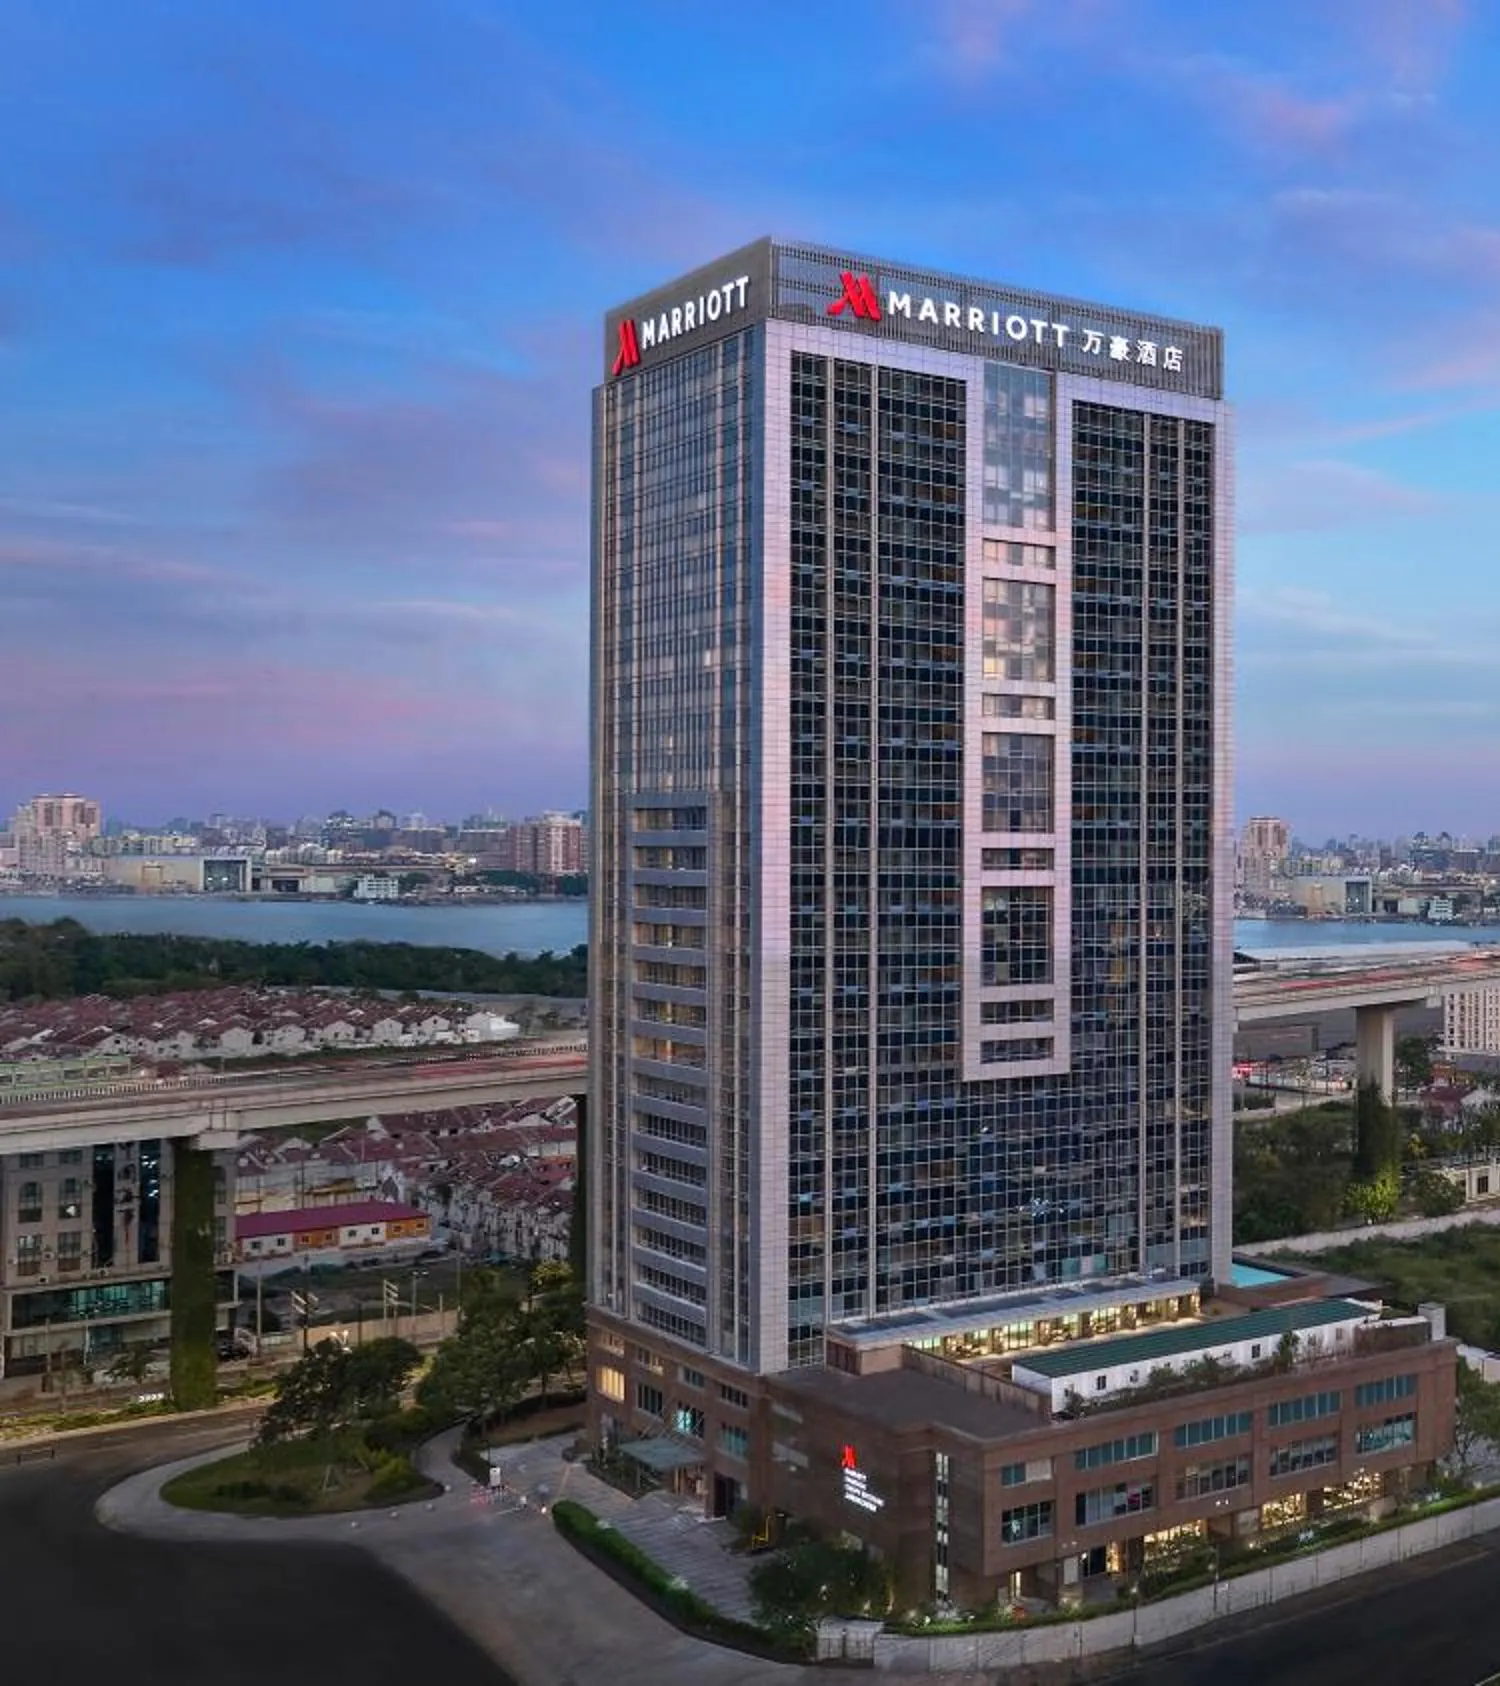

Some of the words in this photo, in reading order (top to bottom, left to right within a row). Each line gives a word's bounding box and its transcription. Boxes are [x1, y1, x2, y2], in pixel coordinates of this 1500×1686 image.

[642, 275, 749, 350] MARRIOTT
[888, 291, 1069, 348] MARRIOTT
[1082, 329, 1183, 373] 万豪酒店
